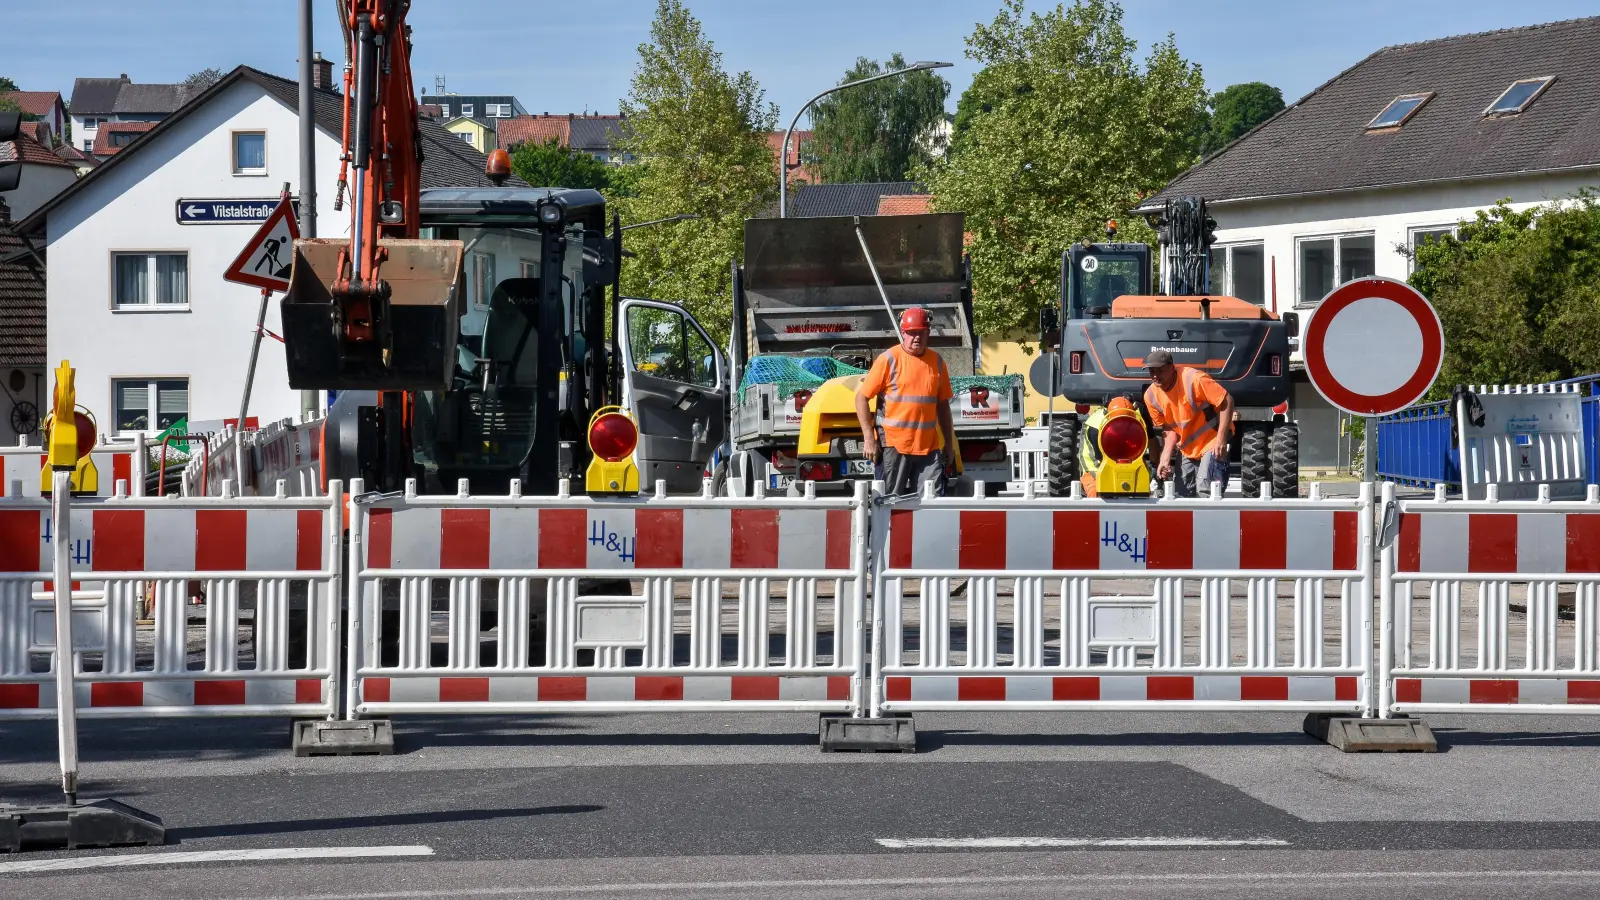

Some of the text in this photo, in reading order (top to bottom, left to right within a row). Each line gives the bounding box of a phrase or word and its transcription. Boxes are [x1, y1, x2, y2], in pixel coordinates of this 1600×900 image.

[212, 204, 274, 218] Vilstalstraße
[1084, 258, 1095, 270] 20
[969, 385, 990, 408] R
[588, 519, 635, 563] H&H
[1101, 520, 1146, 563] H&H
